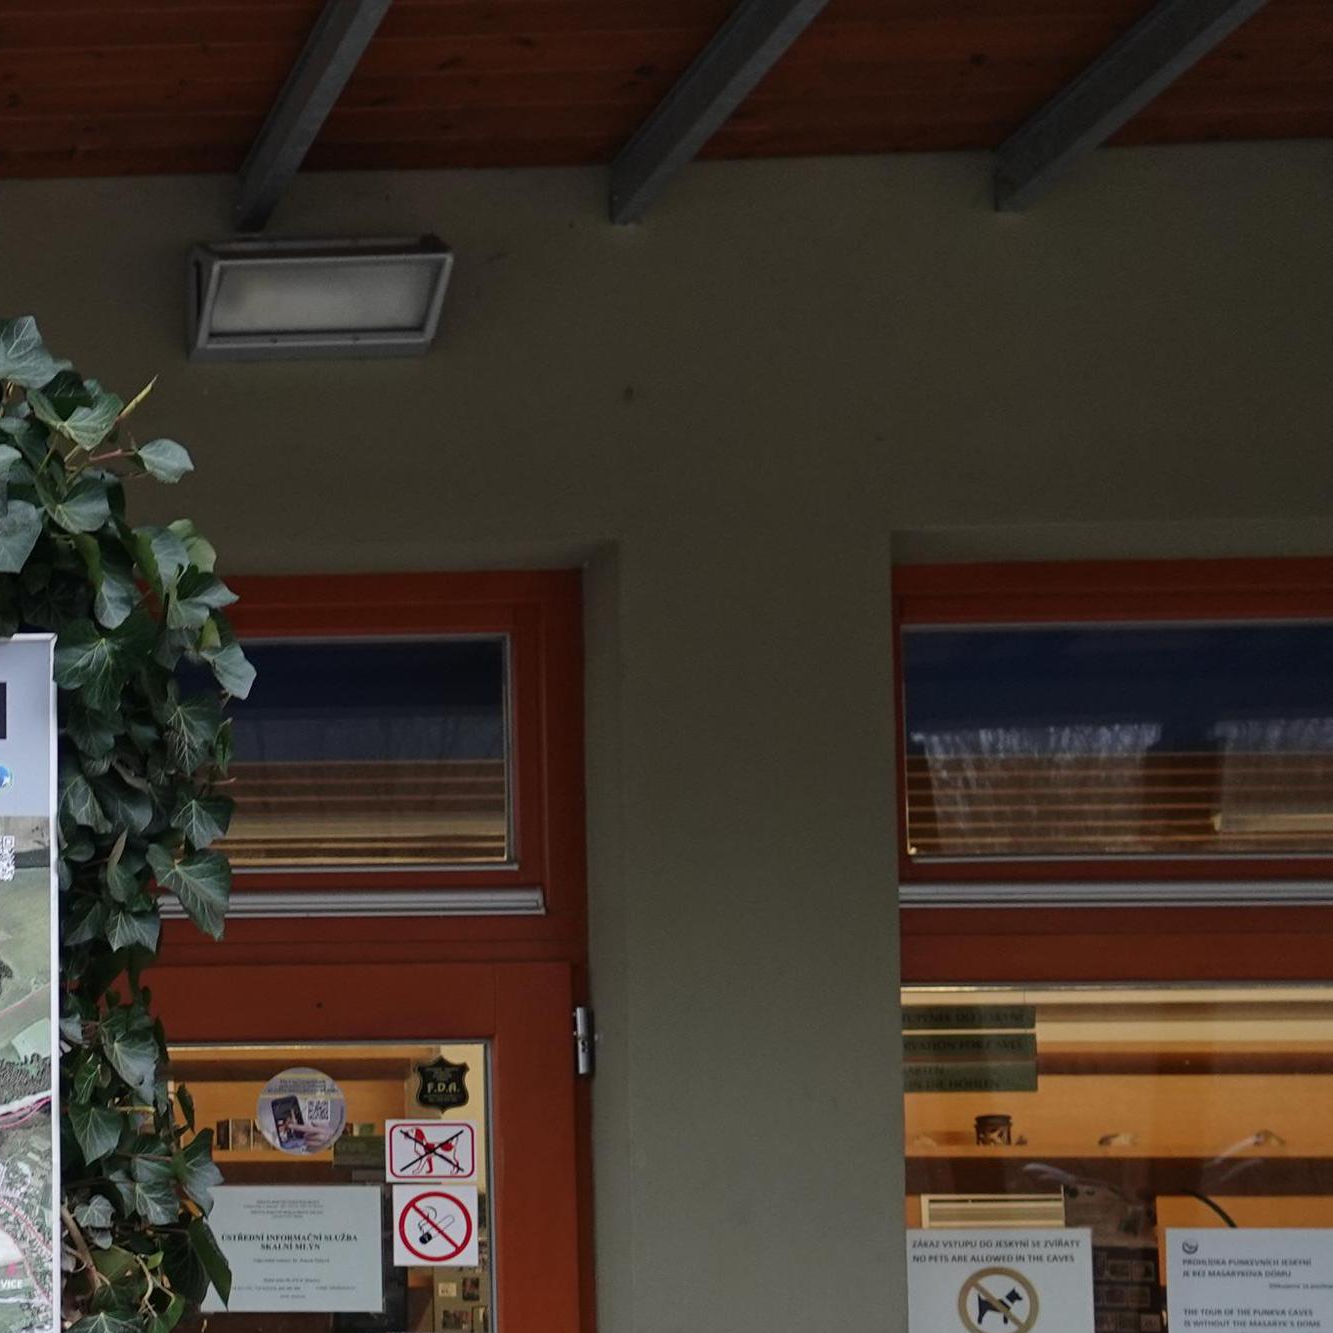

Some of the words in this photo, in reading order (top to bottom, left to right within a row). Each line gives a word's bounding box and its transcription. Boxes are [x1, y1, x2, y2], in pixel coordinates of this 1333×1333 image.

[427, 1082, 459, 1093] F.D.A.
[266, 1232, 322, 1242] INFORMAČNÍ
[324, 1232, 358, 1242] SLUŽBA
[260, 1242, 293, 1251] SKALNÍ
[295, 1242, 320, 1251] MLÝN
[912, 1238, 939, 1248] ZÁKAZ
[942, 1240, 977, 1248] VSTUPU
[979, 1240, 992, 1248] DO
[995, 1238, 1030, 1248] JESKYNÍ
[1032, 1240, 1041, 1248] SE
[1044, 1238, 1080, 1248] ZVÍŘATY
[913, 1255, 927, 1263] NO
[929, 1254, 949, 1263] PETS
[952, 1254, 968, 1262] ARE
[970, 1254, 1014, 1262] ALLOWED
[1016, 1254, 1025, 1262] IN
[1028, 1254, 1044, 1262] THE
[1046, 1254, 1075, 1262] CAVES
[1182, 1258, 1226, 1266] PROHLÍDKA
[1228, 1257, 1279, 1266] PUNKEVNÍCH
[1281, 1257, 1312, 1266] JESKYNÍ
